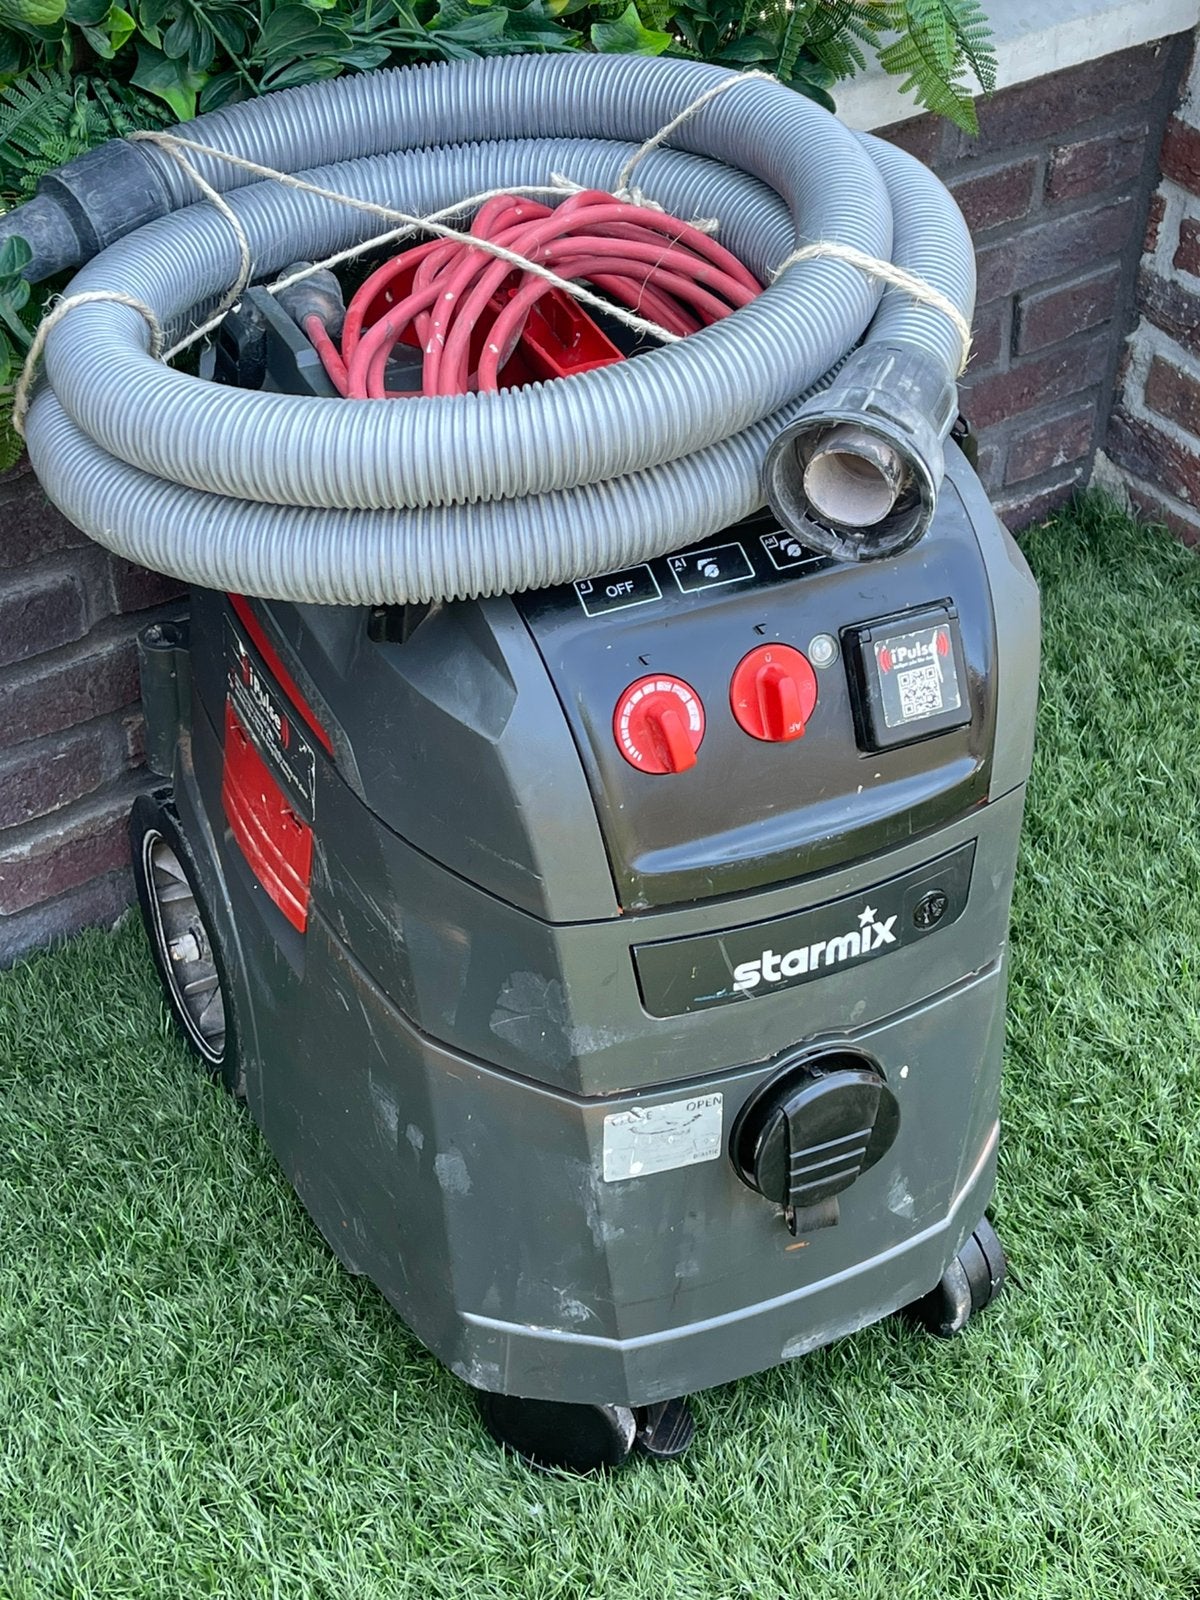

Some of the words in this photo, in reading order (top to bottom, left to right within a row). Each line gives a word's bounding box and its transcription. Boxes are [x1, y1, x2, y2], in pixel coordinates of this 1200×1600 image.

[606, 580, 635, 597] OFF
[733, 906, 899, 991] starmix
[686, 1096, 722, 1112] OPEN
